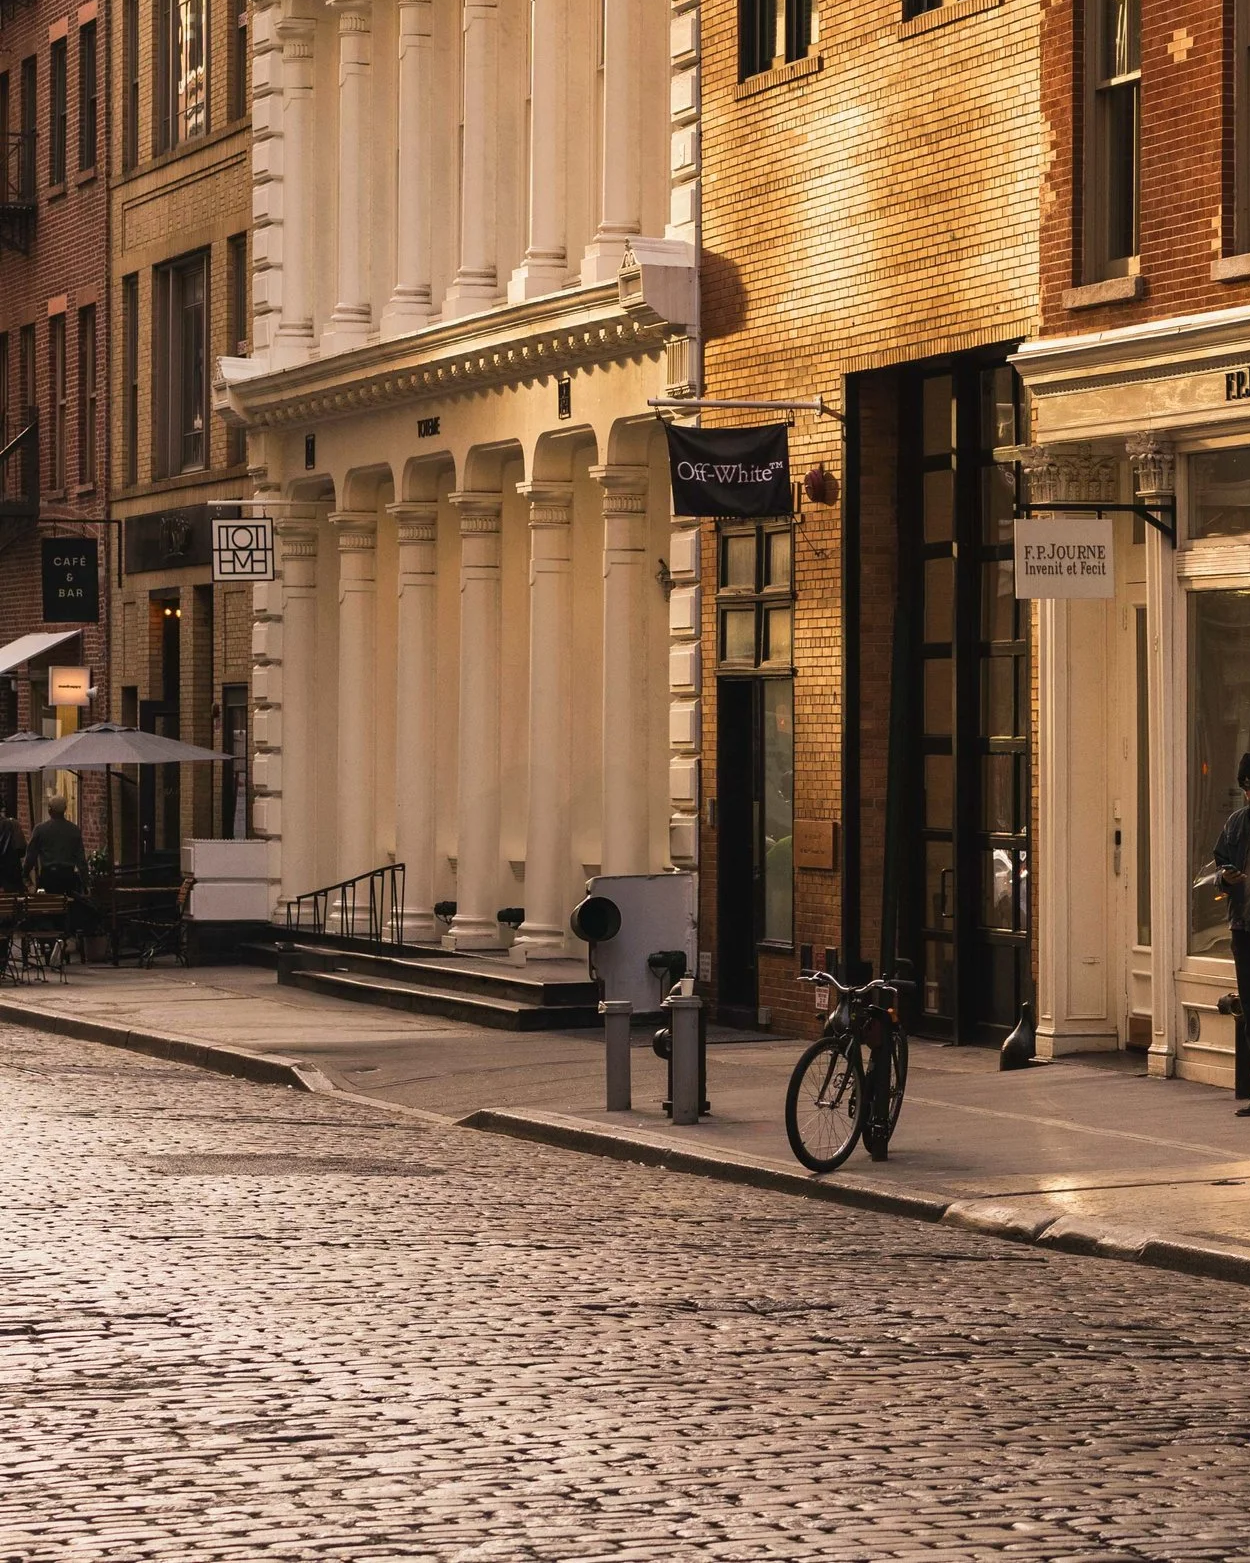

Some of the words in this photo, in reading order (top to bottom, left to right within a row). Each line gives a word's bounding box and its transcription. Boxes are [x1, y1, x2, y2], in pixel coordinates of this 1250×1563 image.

[1025, 561, 1063, 575] Invenit
[1066, 563, 1077, 575] et
[1080, 561, 1107, 575] Fecit
[66, 573, 73, 582] &
[58, 589, 83, 598] BAR
